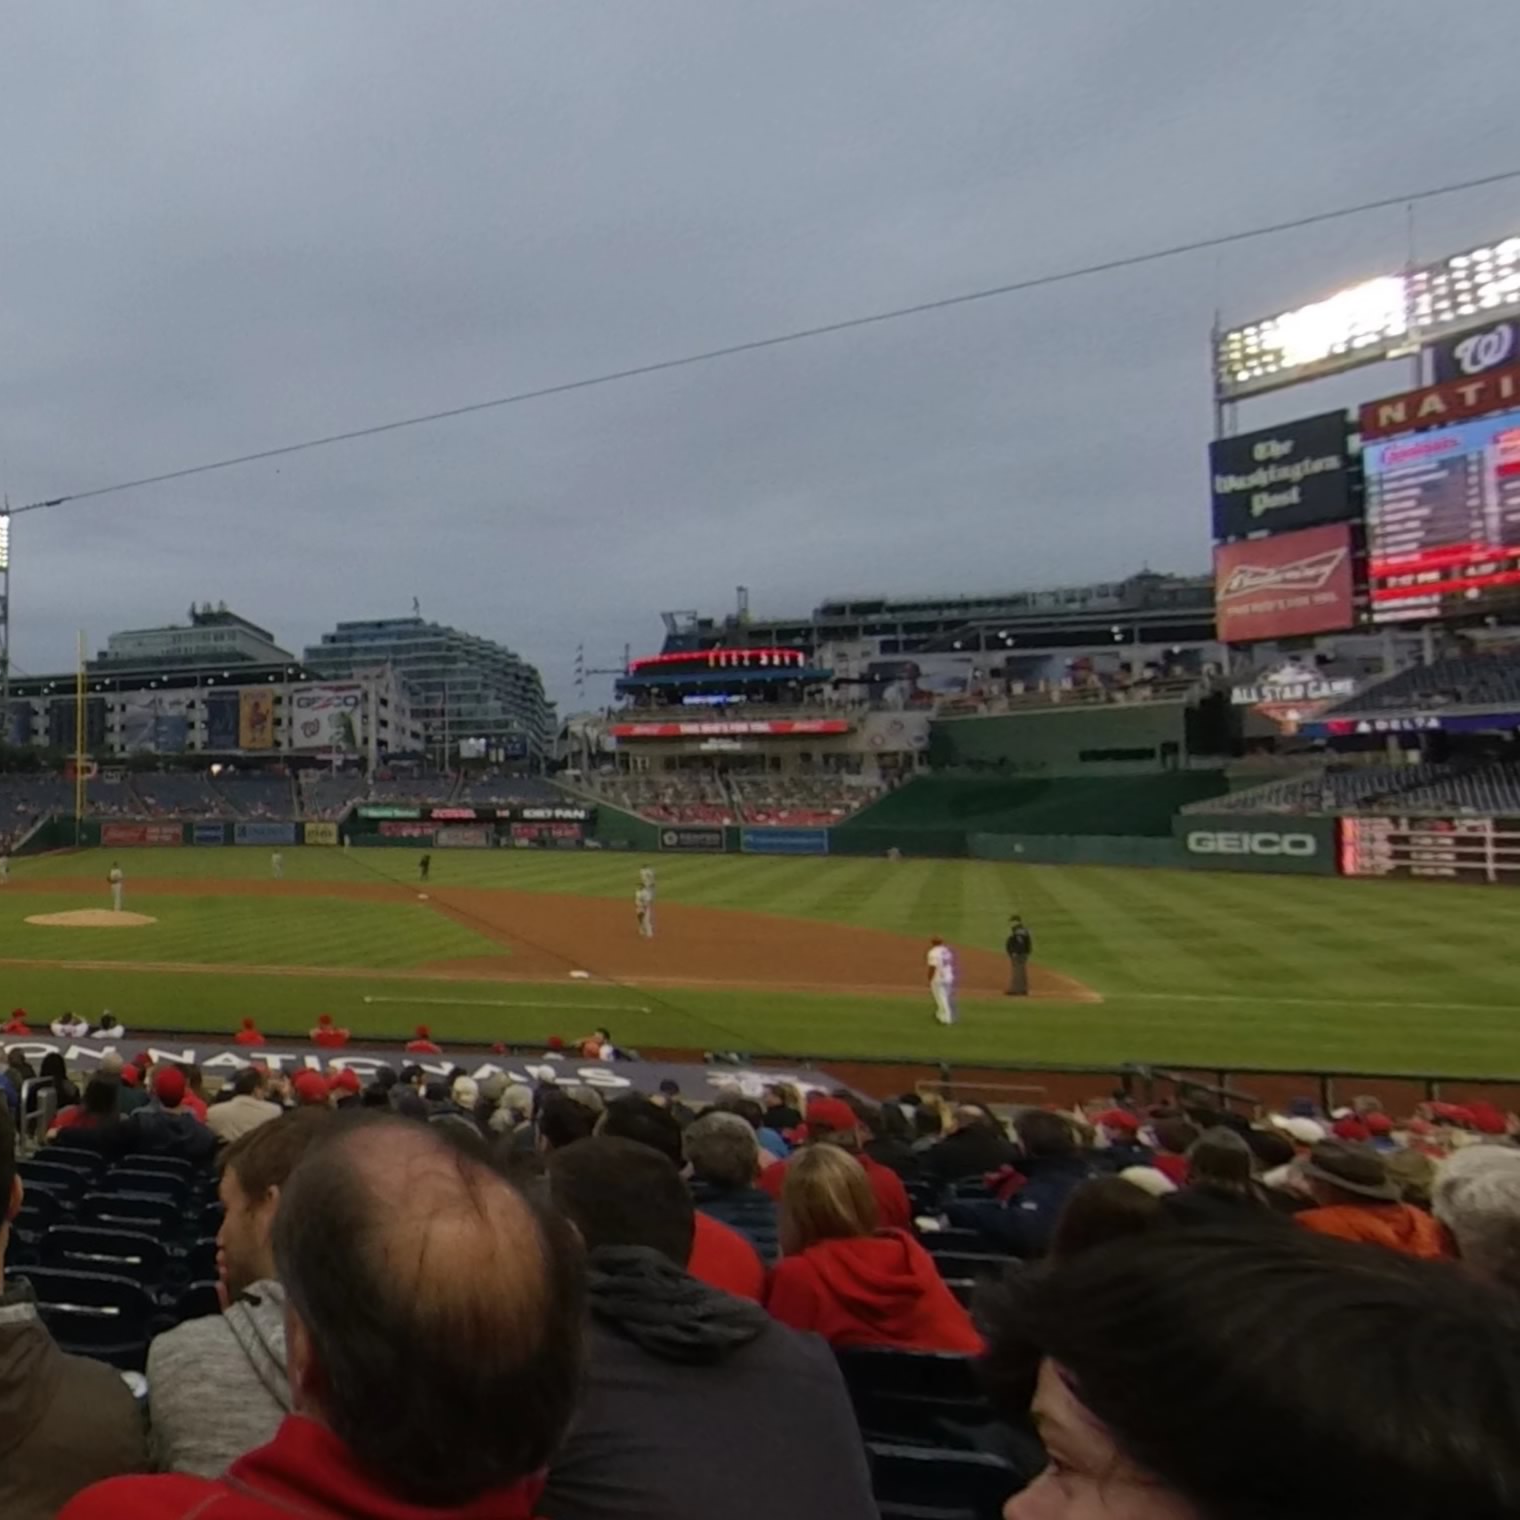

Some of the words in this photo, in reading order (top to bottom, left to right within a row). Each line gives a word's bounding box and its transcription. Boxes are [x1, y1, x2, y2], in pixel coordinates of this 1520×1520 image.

[1253, 439, 1296, 462] The
[1215, 454, 1342, 494] Washington
[1250, 485, 1302, 518] Post
[1231, 685, 1258, 705] ALL
[1261, 682, 1305, 702] STAR
[1307, 678, 1357, 699] GAME
[1375, 717, 1441, 731] DELTA
[1186, 831, 1317, 857] GEICO
